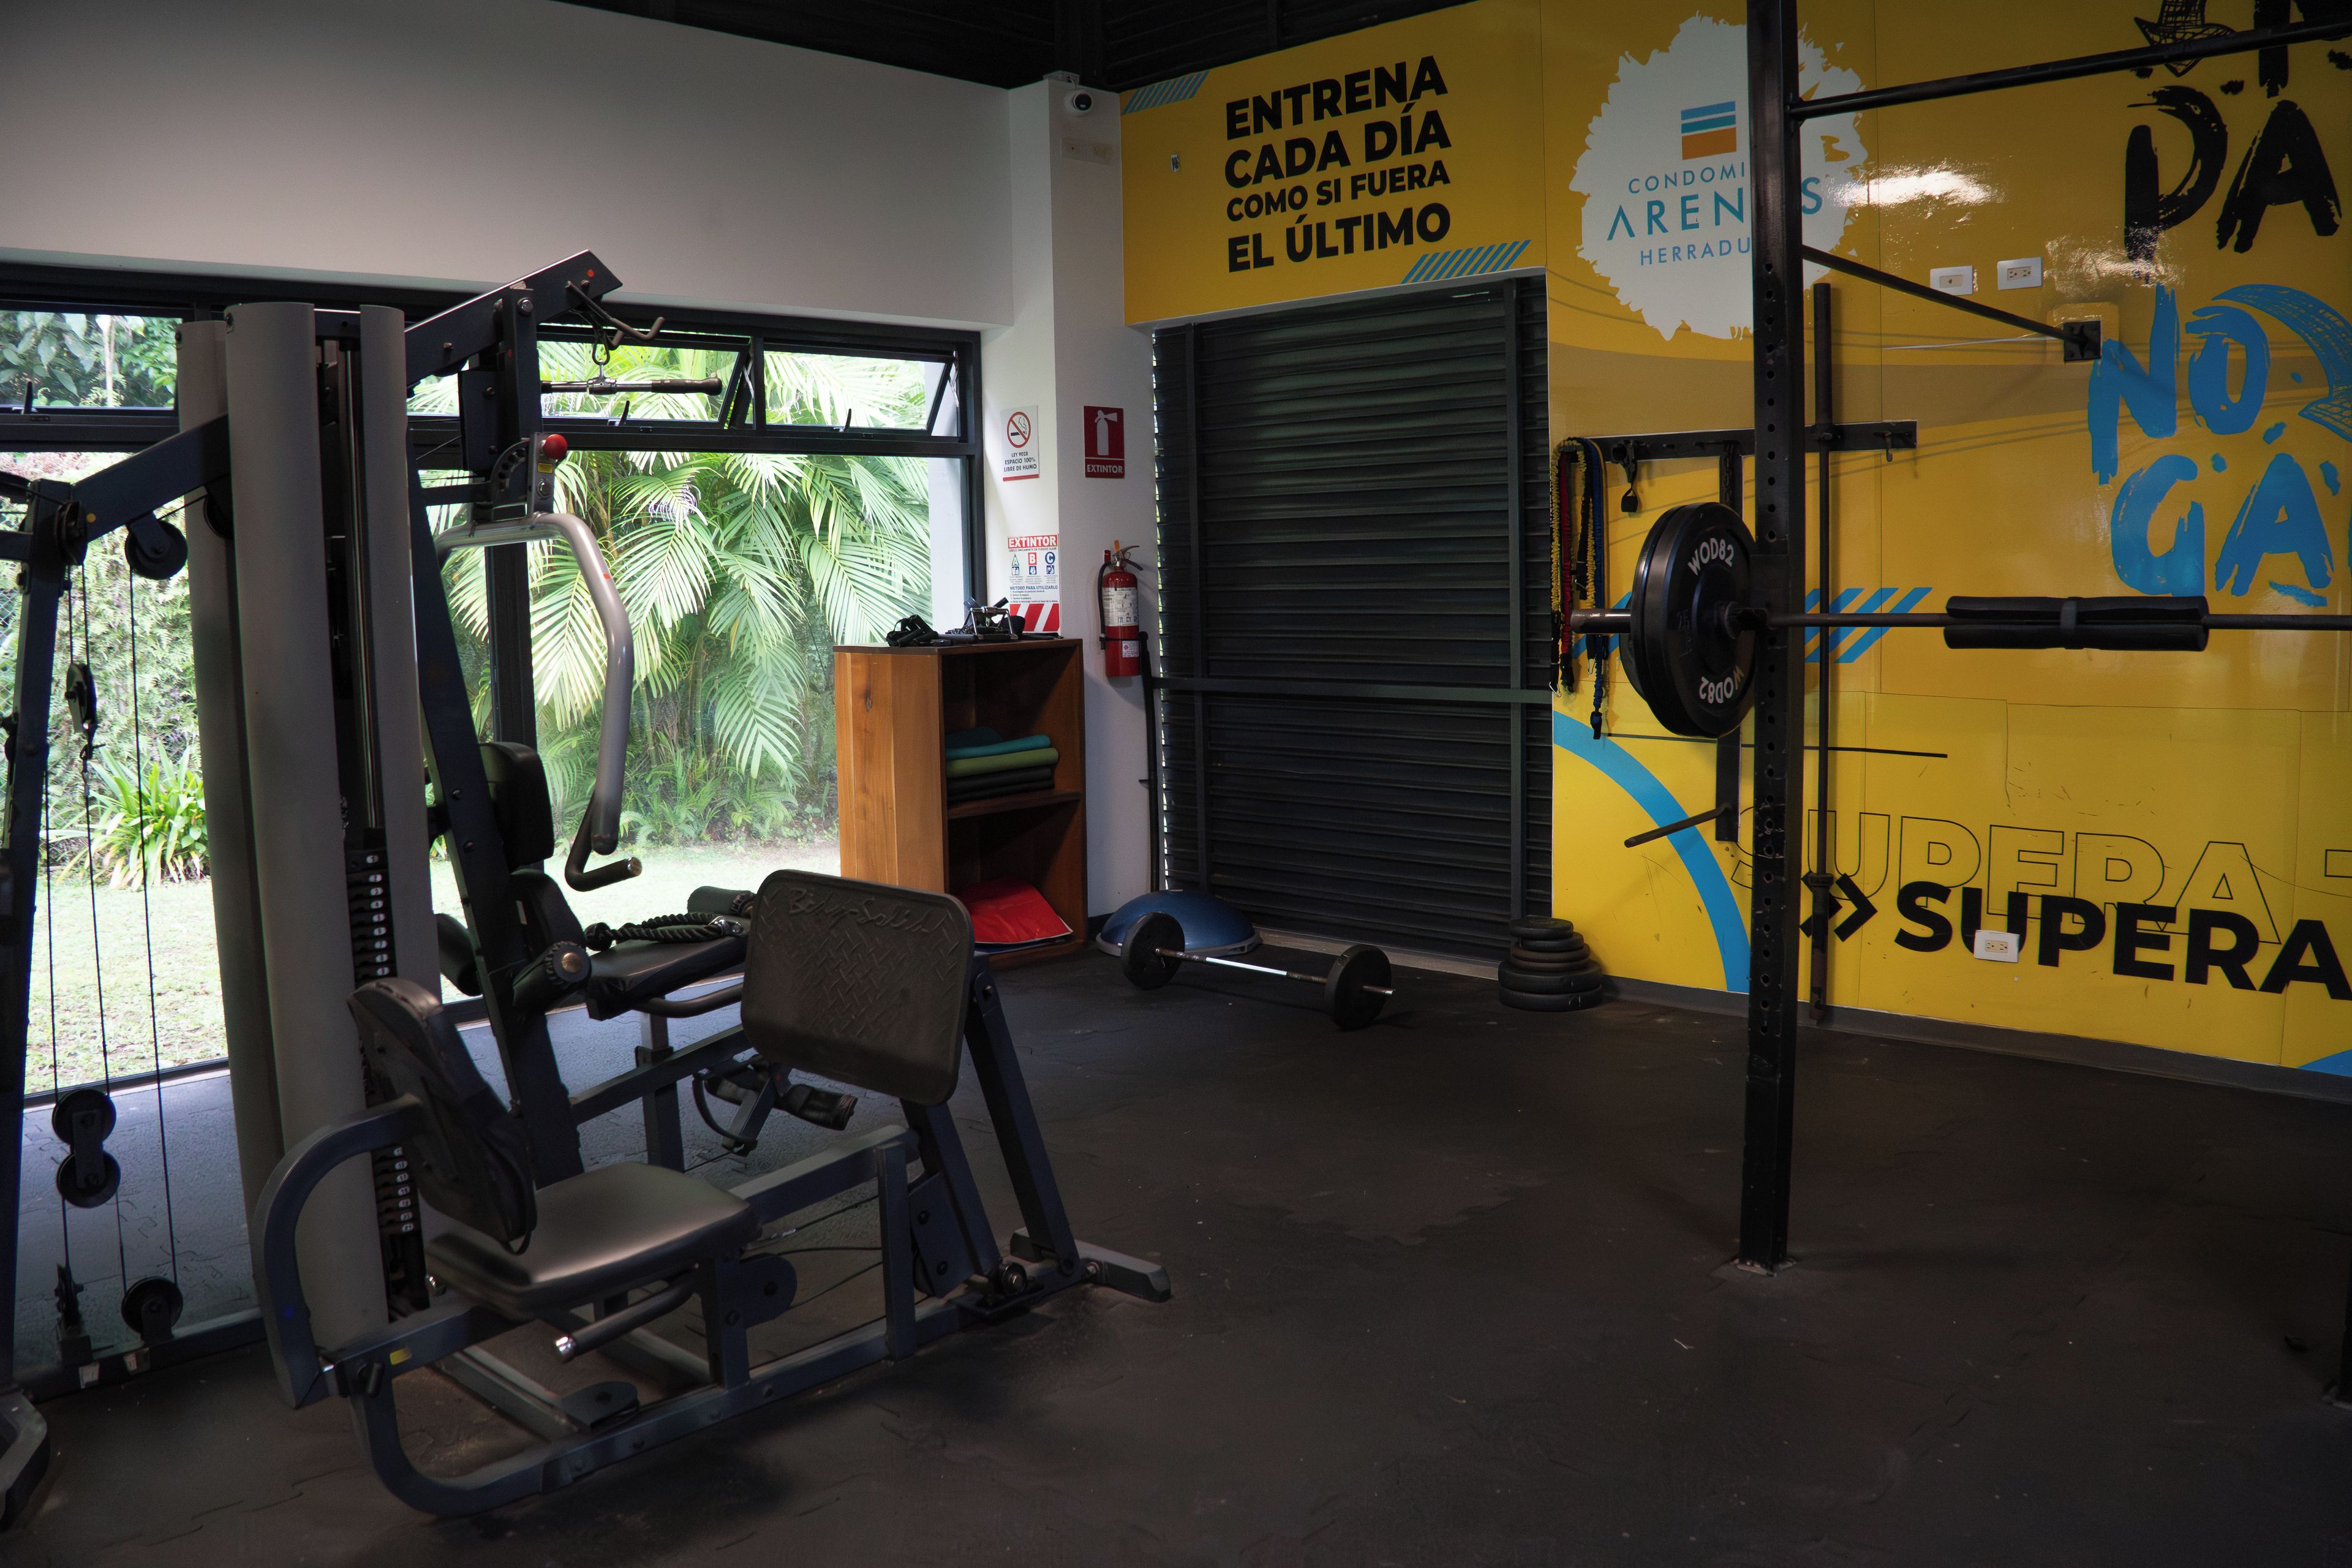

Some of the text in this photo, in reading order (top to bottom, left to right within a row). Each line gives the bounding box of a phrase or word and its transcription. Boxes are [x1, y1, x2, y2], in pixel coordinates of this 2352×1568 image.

[1225, 55, 1449, 141] ENTRENA
[1224, 101, 1452, 189] CADA DÍA
[1226, 160, 1451, 222] COMO SI FUERA
[1628, 161, 1746, 195] CONDOMI
[1607, 176, 1823, 242] ARENS
[1228, 203, 1452, 273] EL ÚLTIMO
[1640, 235, 1752, 266] HERRADU
[1087, 464, 1123, 475] EXTINTOR
[1008, 536, 1057, 548] EXTINTOR
[2111, 453, 2352, 598] GA
[1029, 553, 1036, 565] B
[1687, 537, 1735, 576] WOD82
[1698, 664, 1744, 704] WOD82
[1894, 880, 2352, 1001] SUPERA
